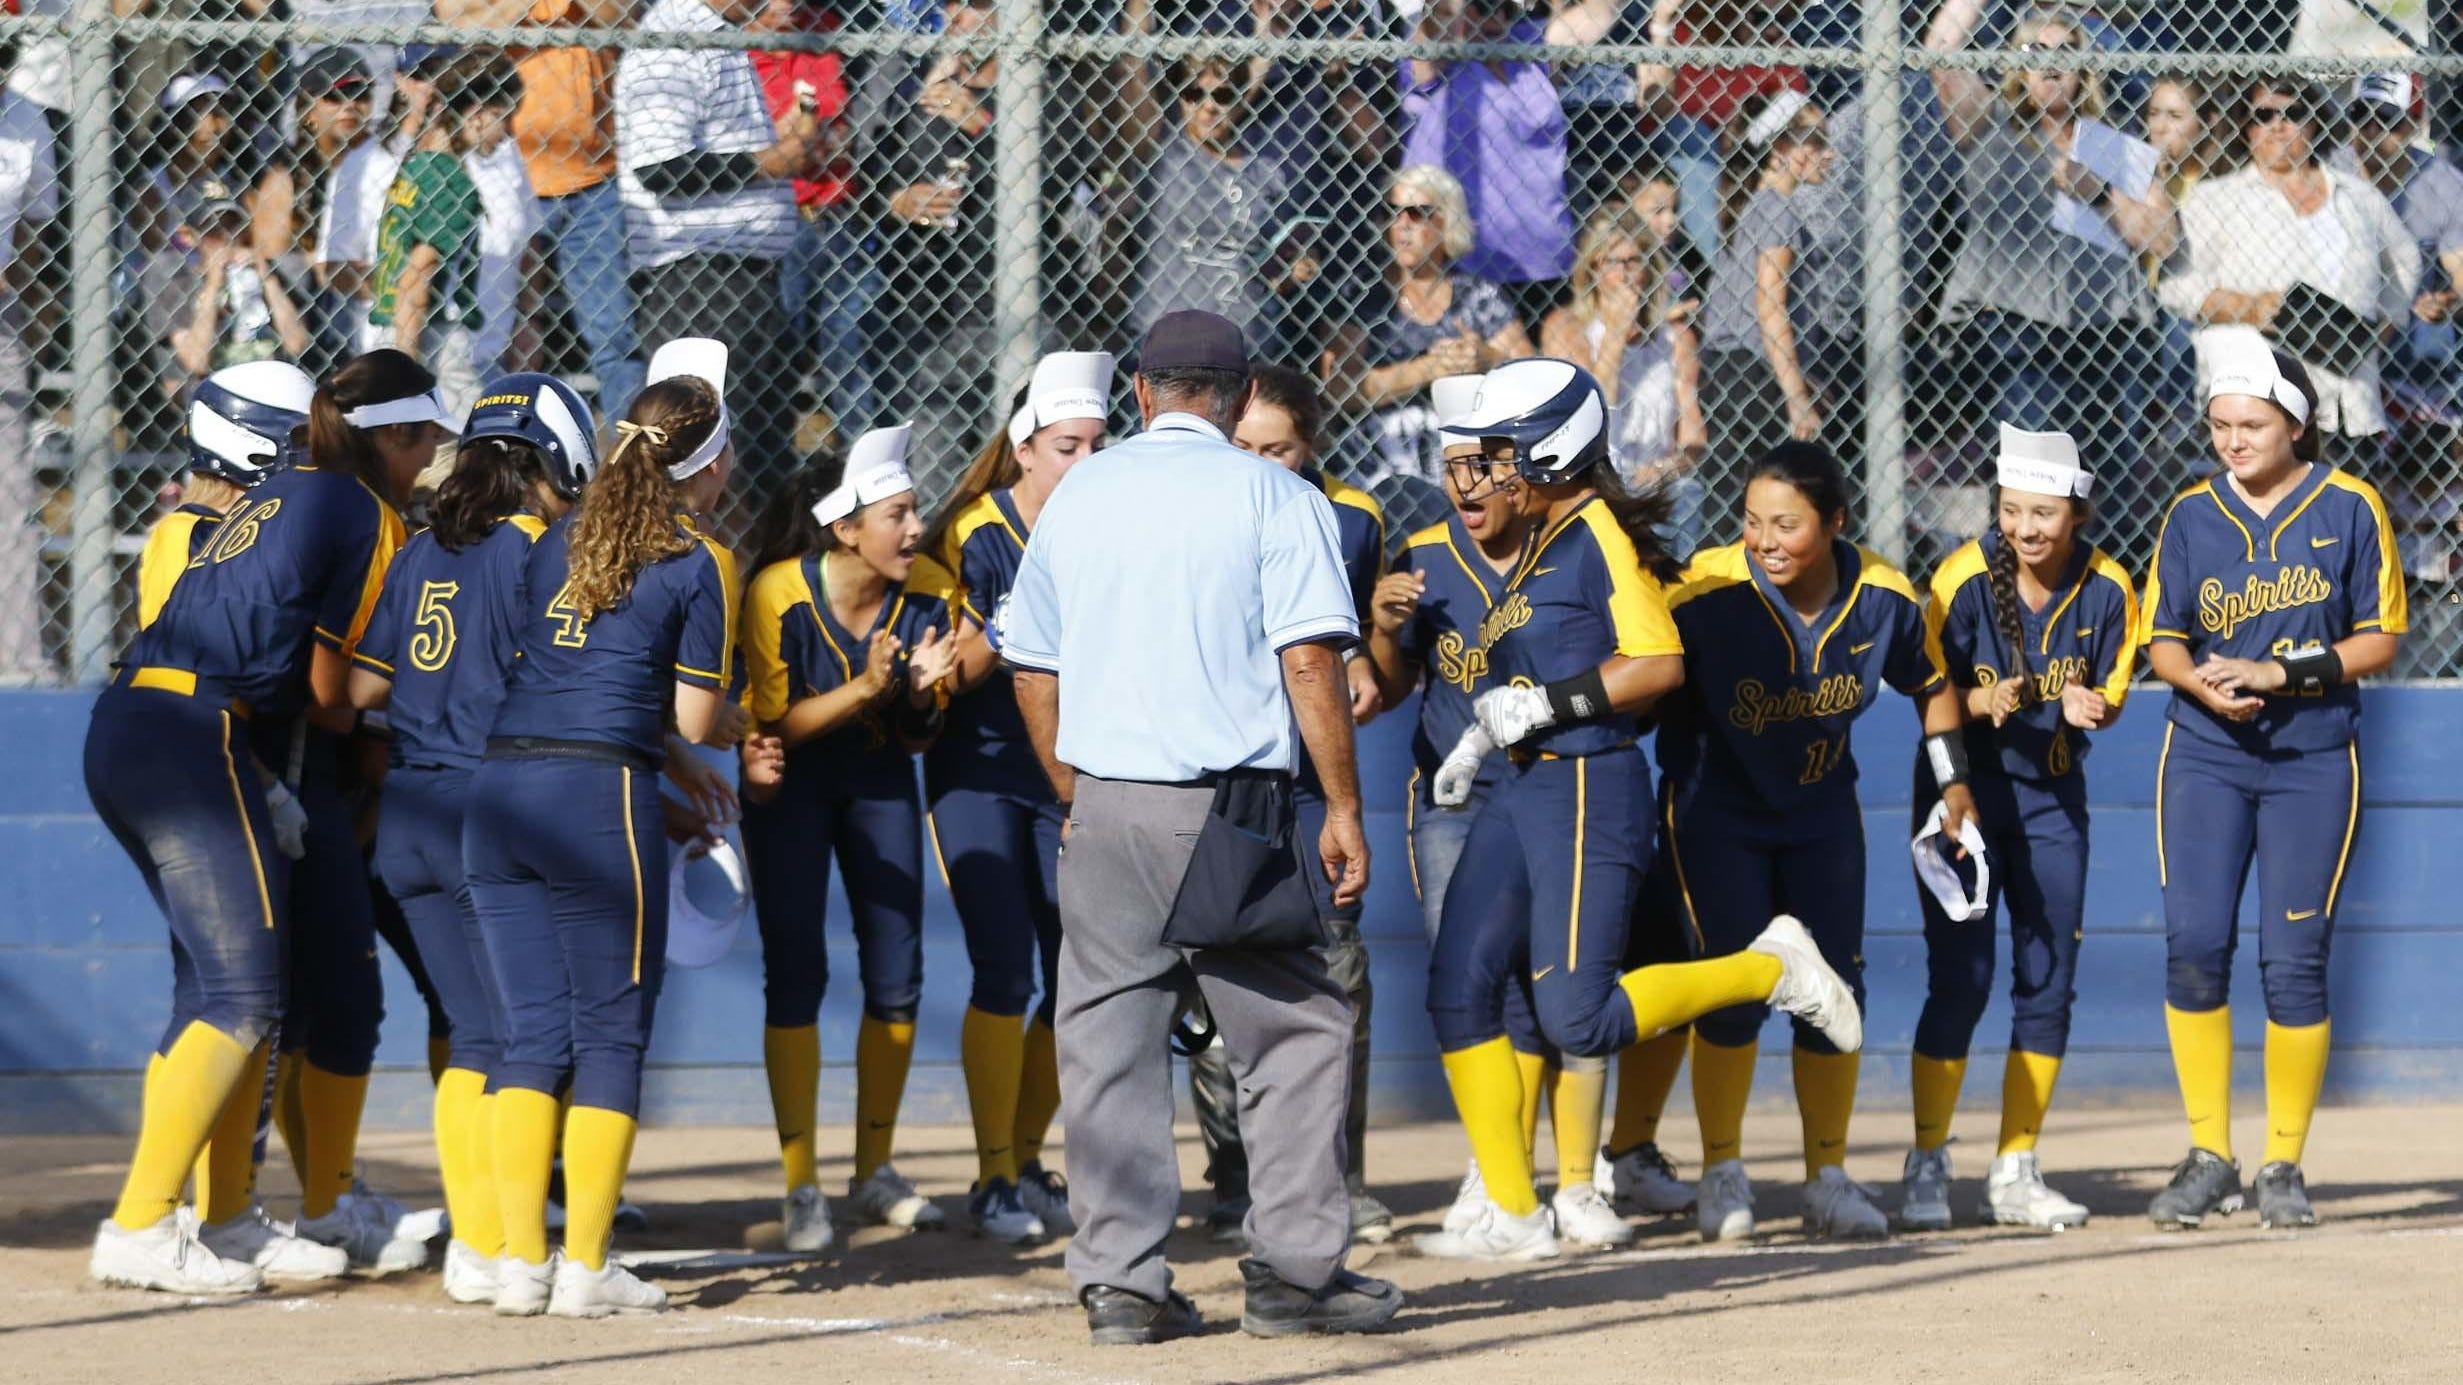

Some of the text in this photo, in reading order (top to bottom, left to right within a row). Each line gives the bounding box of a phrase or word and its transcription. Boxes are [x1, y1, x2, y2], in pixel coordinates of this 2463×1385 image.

[188, 498, 281, 570] 16
[409, 580, 460, 672] 5
[2199, 564, 2331, 640] Spirits
[1729, 674, 1863, 736] Spirits
